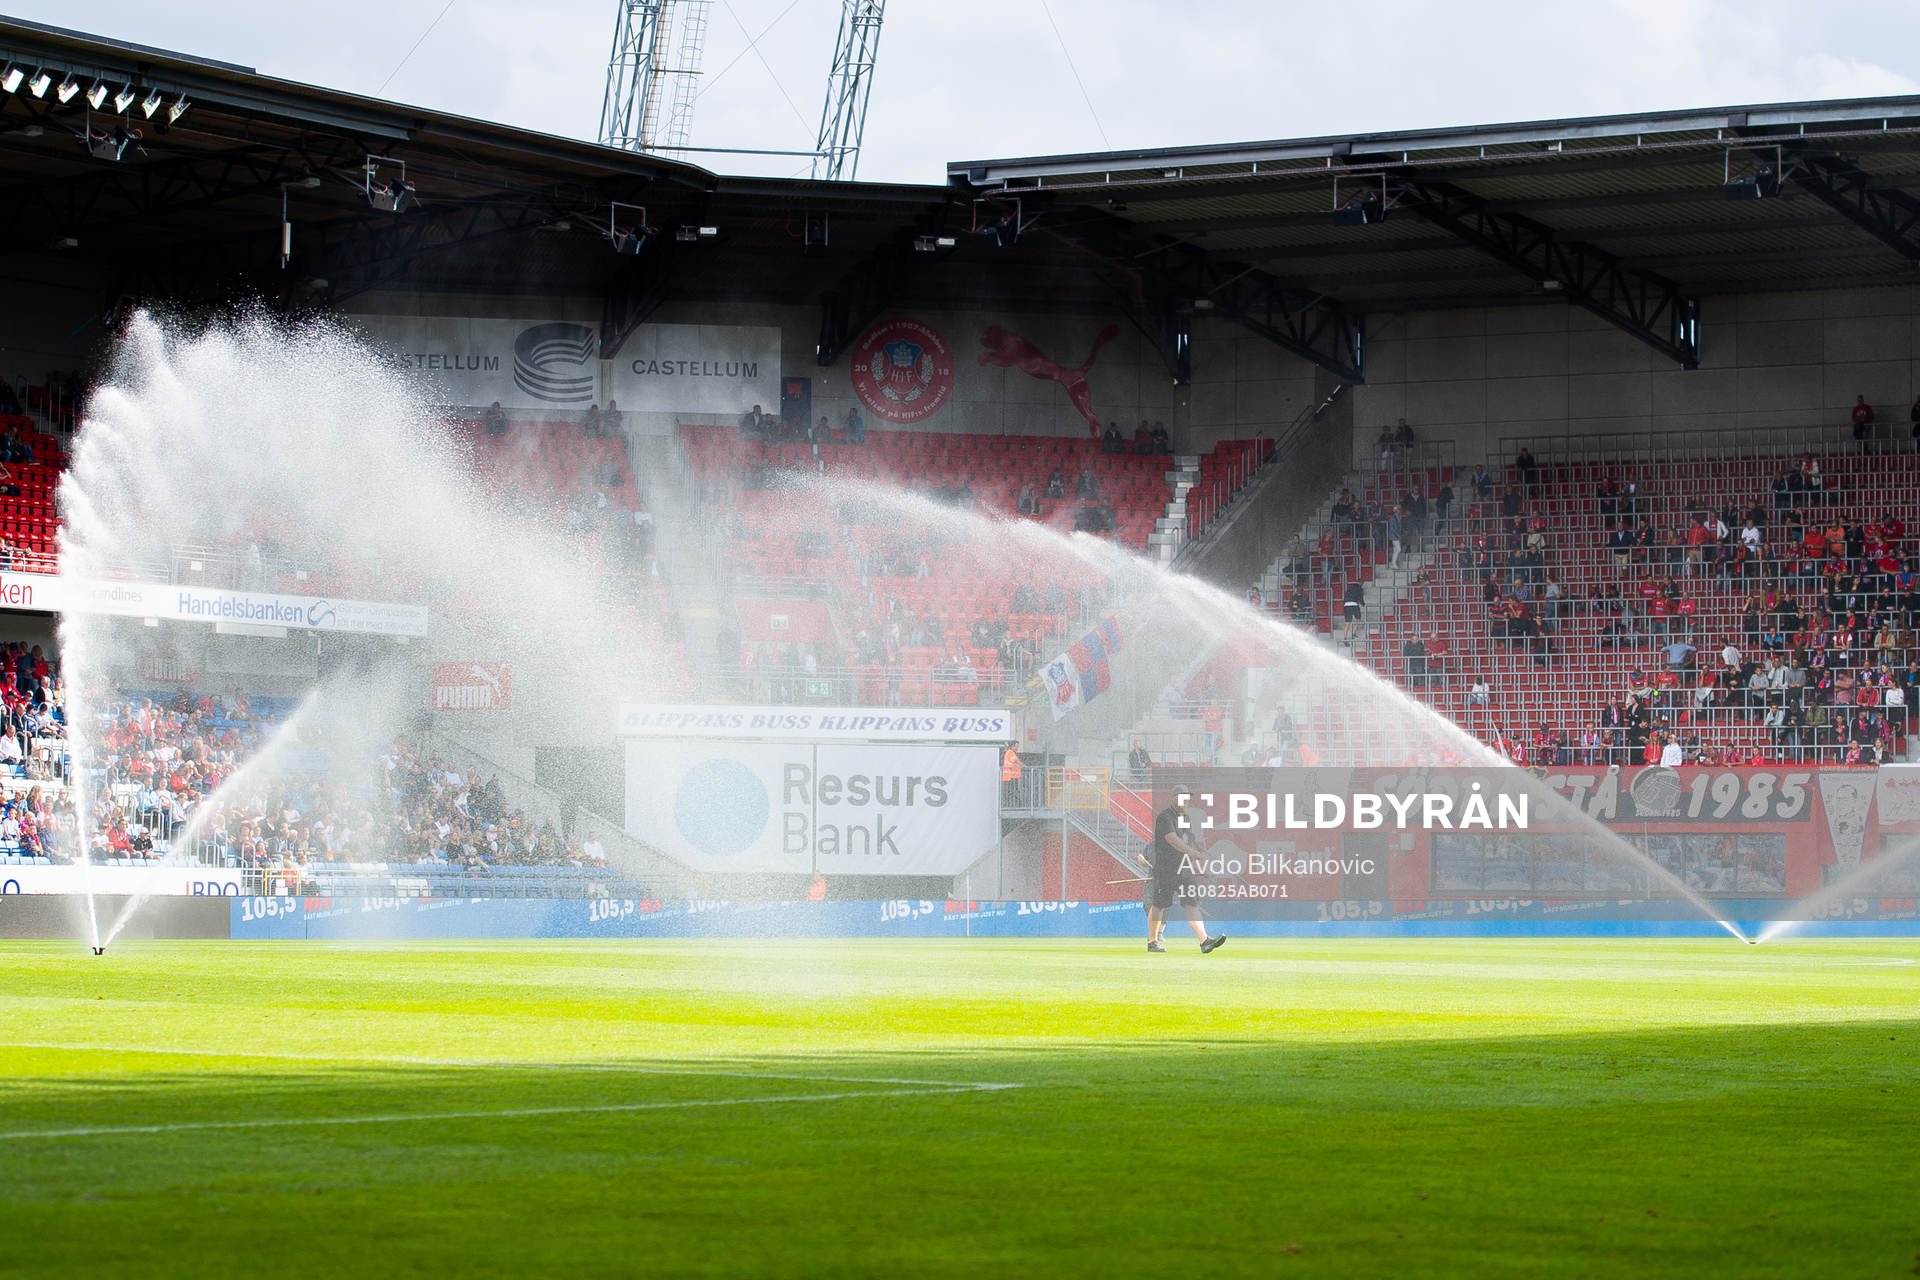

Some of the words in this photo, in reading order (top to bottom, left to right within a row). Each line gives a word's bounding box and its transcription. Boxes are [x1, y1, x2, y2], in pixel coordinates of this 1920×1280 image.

[399, 353, 500, 371] STELLUM
[631, 359, 759, 378] CASTELLUM
[855, 364, 868, 372] 20
[178, 591, 303, 622] Handelsbanken
[624, 711, 744, 729] KLIPPANS
[749, 714, 812, 729] BUSS
[818, 716, 937, 732] KLIPPANS
[942, 717, 1004, 733] BUSS
[783, 762, 949, 808] Resurs
[1687, 773, 1813, 820] 1985
[783, 812, 901, 856] Bank
[241, 896, 297, 922] 105,5
[880, 900, 934, 922] 105,5
[1316, 900, 1383, 923] 105,5
